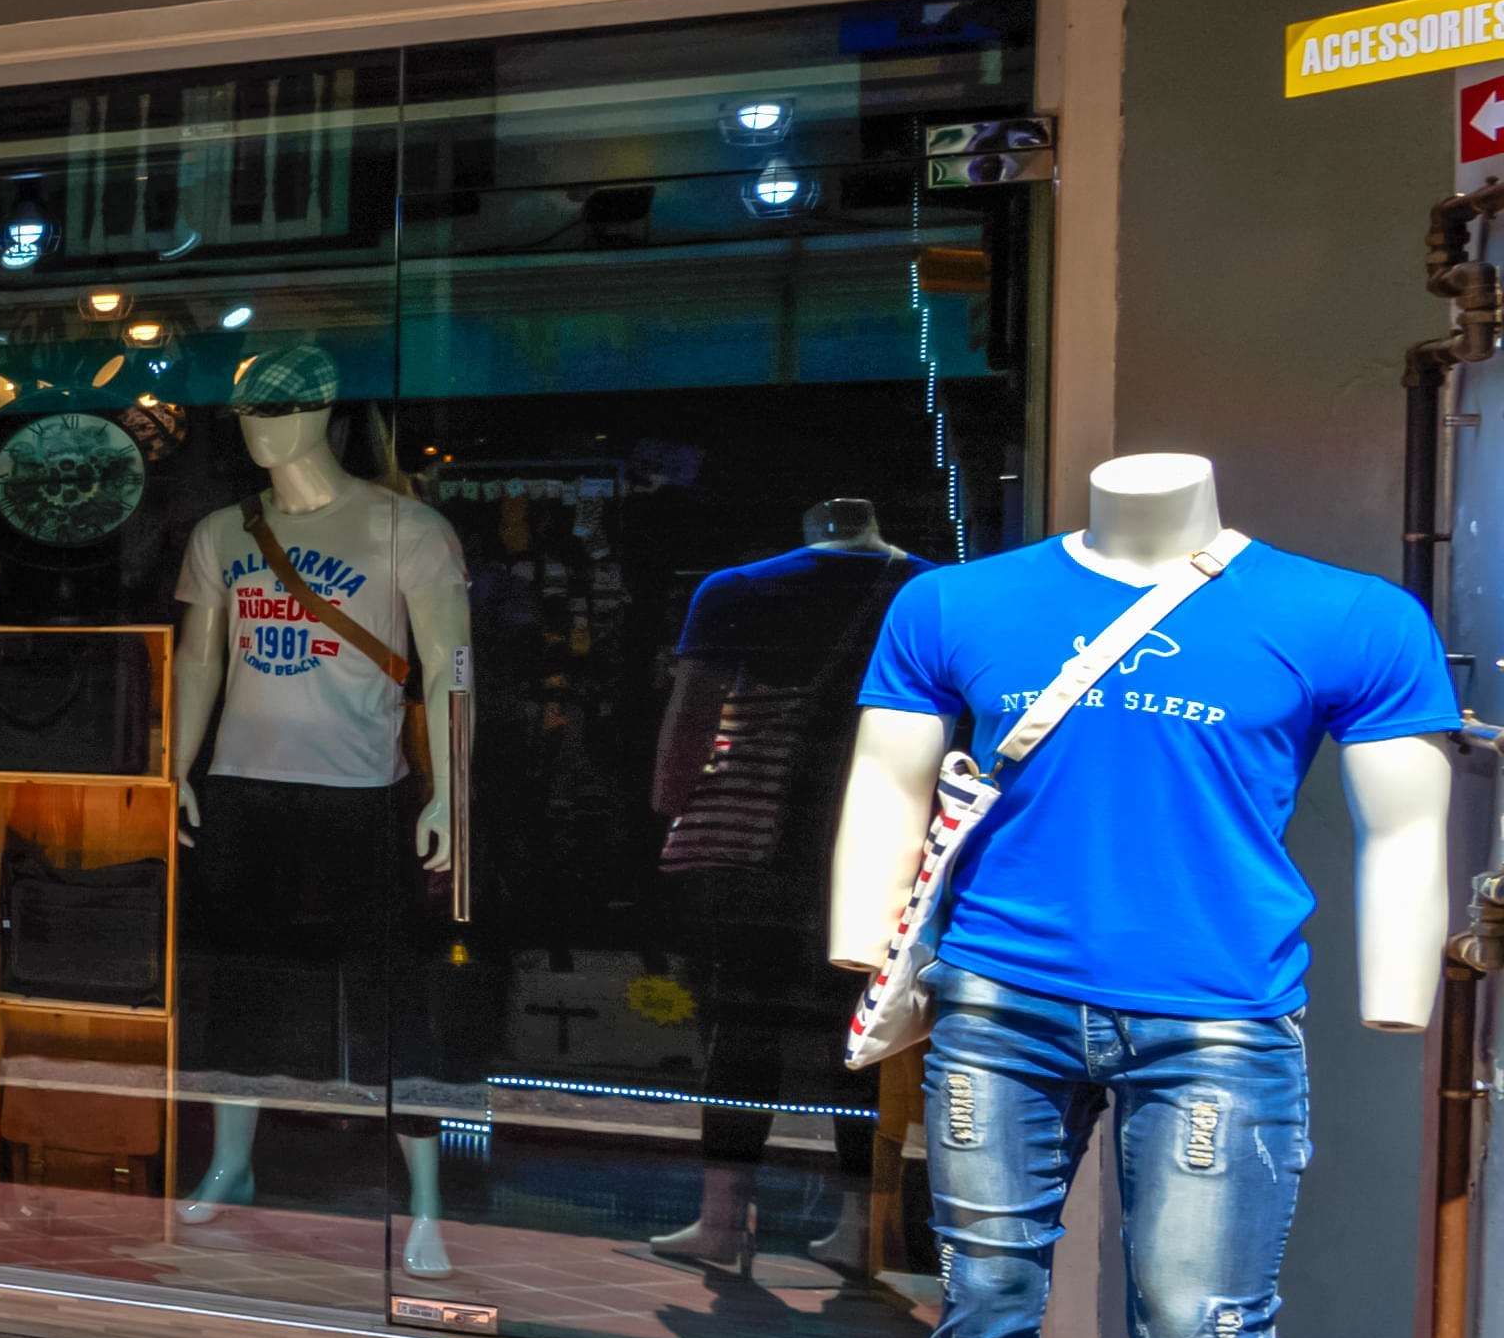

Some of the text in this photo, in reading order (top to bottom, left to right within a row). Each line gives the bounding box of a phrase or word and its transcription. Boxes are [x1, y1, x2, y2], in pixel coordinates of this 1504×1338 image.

[1301, 0, 1504, 76] ACCESSORIES
[223, 546, 367, 598] CALIORNIA
[239, 597, 341, 623] RUDED
[256, 626, 308, 660] 1981
[244, 651, 321, 676] LONG BEACH
[455, 650, 464, 683] PULL
[1001, 688, 1226, 726] NER SLEEP
